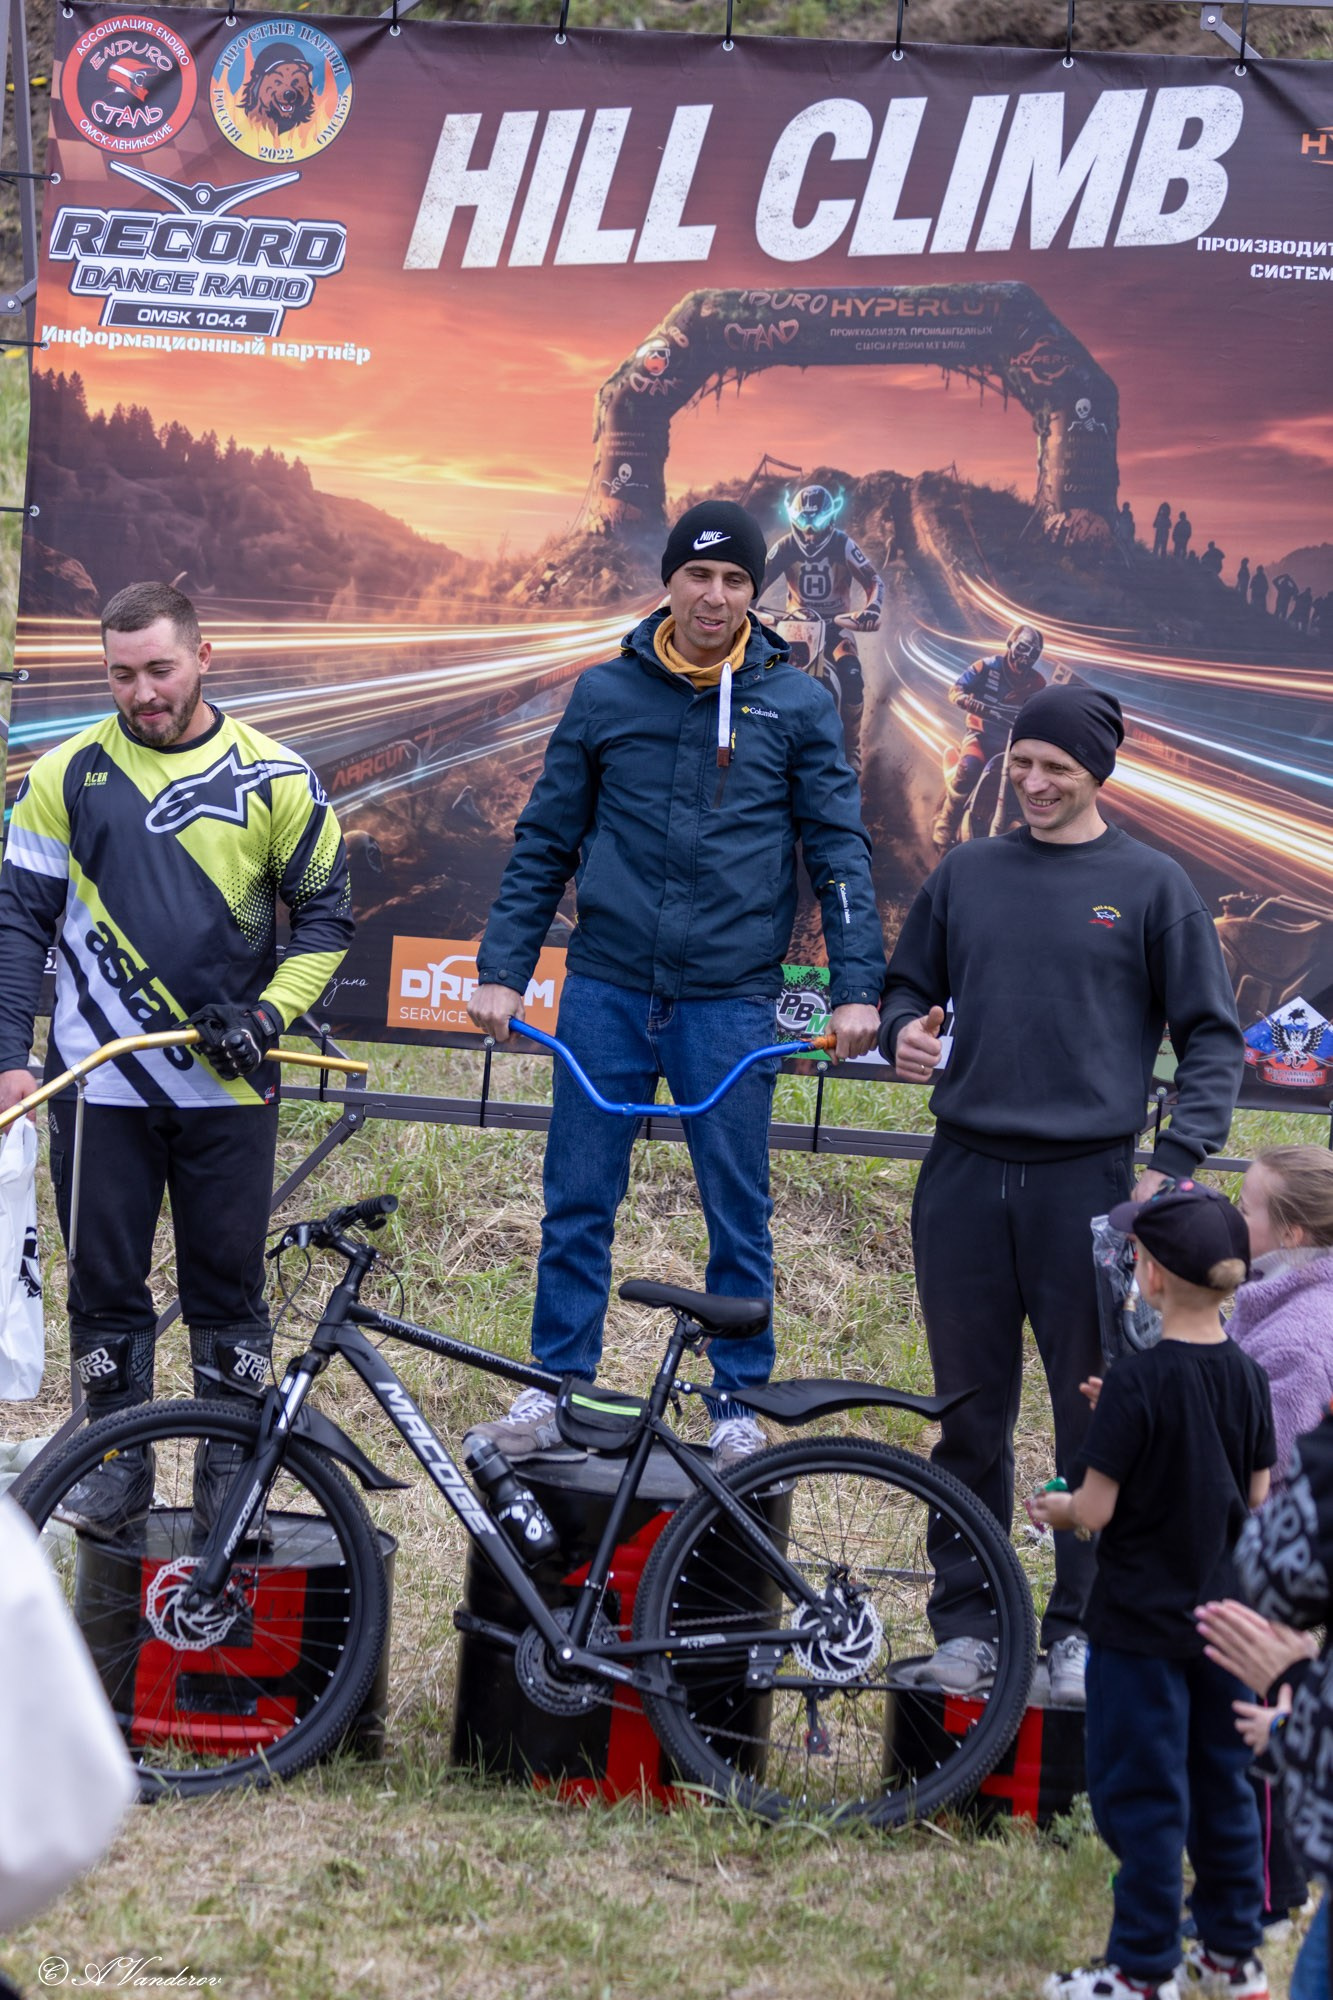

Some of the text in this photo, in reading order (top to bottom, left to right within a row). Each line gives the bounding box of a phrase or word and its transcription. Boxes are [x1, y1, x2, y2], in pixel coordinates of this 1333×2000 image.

[89, 40, 173, 71] ENDURO
[220, 22, 347, 76] ПРОСТЫЕ ПАРНИ
[213, 88, 243, 142] РОССИЯ
[80, 119, 173, 150] ОМСК-ЛЕНИНСКИЕ
[1301, 133, 1333, 155] H
[259, 146, 295, 160] 2022
[402, 85, 1244, 270] HILL CLIMB
[50, 212, 346, 271] RECORD
[76, 265, 309, 302] DANCE RADIO
[137, 308, 247, 328] OMSK 104.4
[42, 325, 371, 366] Информационный партнёр
[700, 530, 723, 541] NIKE
[749, 706, 779, 719] Columbia
[400, 964, 555, 1009] DREM
[399, 1006, 468, 1024] SERVICE
[375, 1382, 498, 1536] MACOGE
